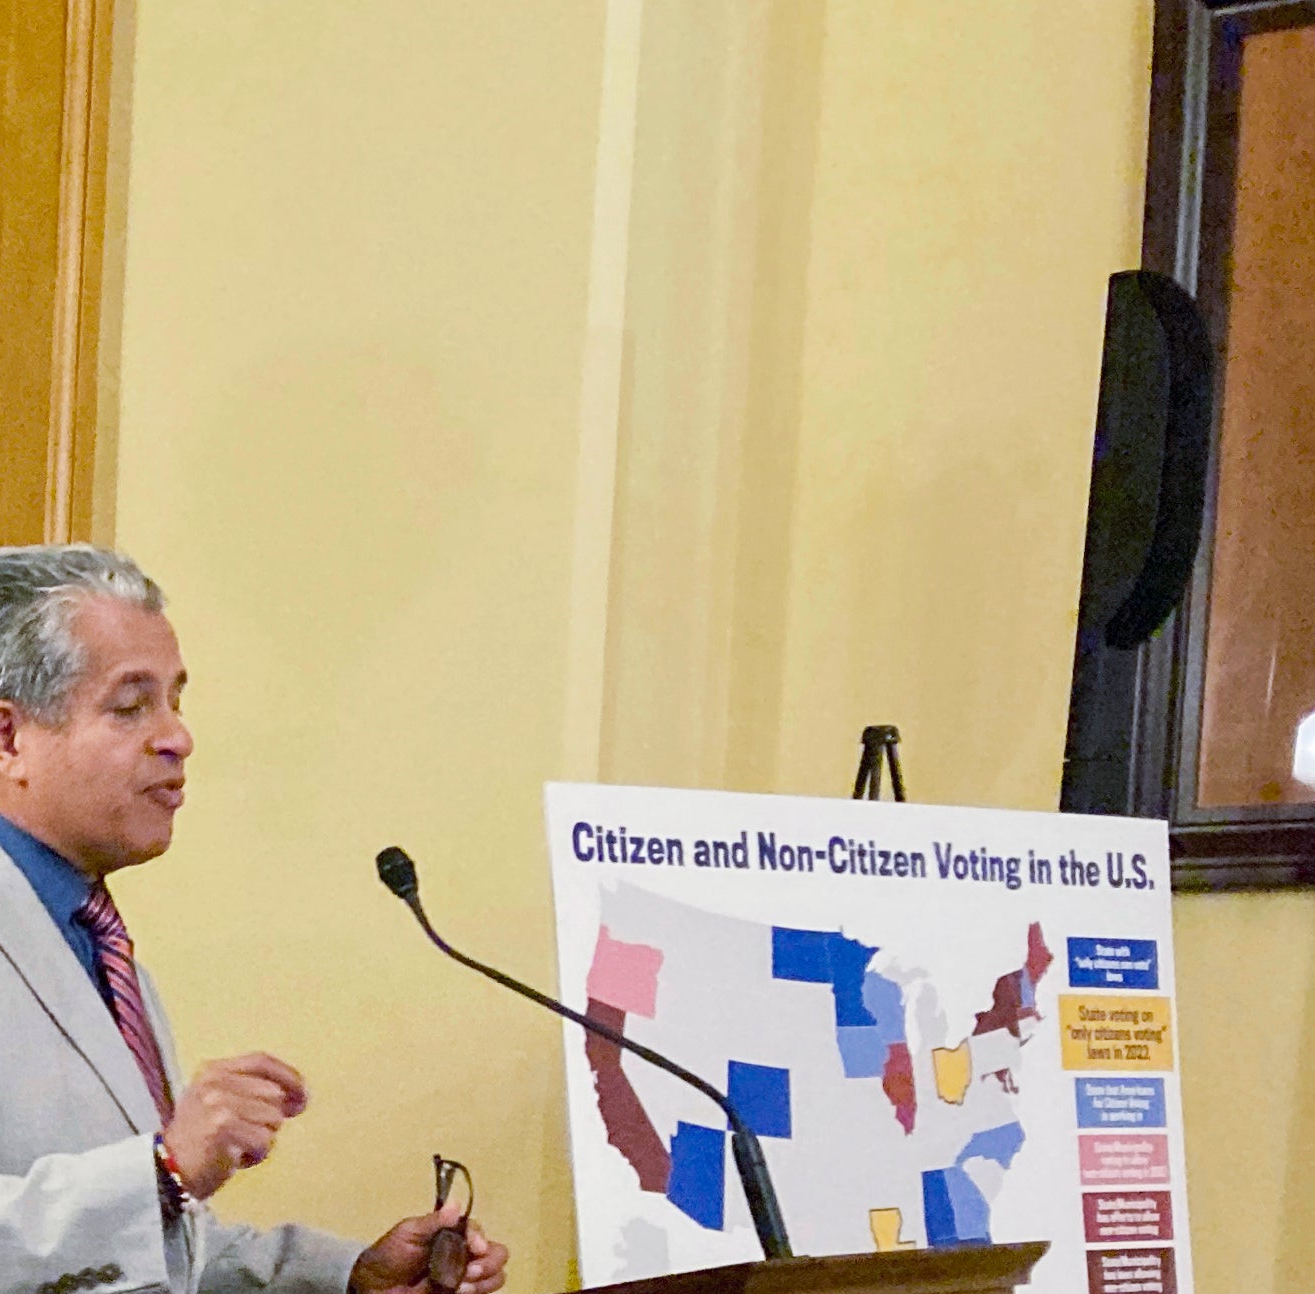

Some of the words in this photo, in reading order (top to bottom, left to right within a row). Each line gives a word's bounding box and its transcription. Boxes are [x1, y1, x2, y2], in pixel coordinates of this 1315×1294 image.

[572, 821, 684, 867] Citizen
[694, 830, 750, 869] and
[757, 831, 926, 878] Non-Citizen
[933, 841, 1022, 891] Voting
[1028, 849, 1052, 885] in
[1058, 849, 1101, 887] the
[1106, 852, 1155, 890] U.S.
